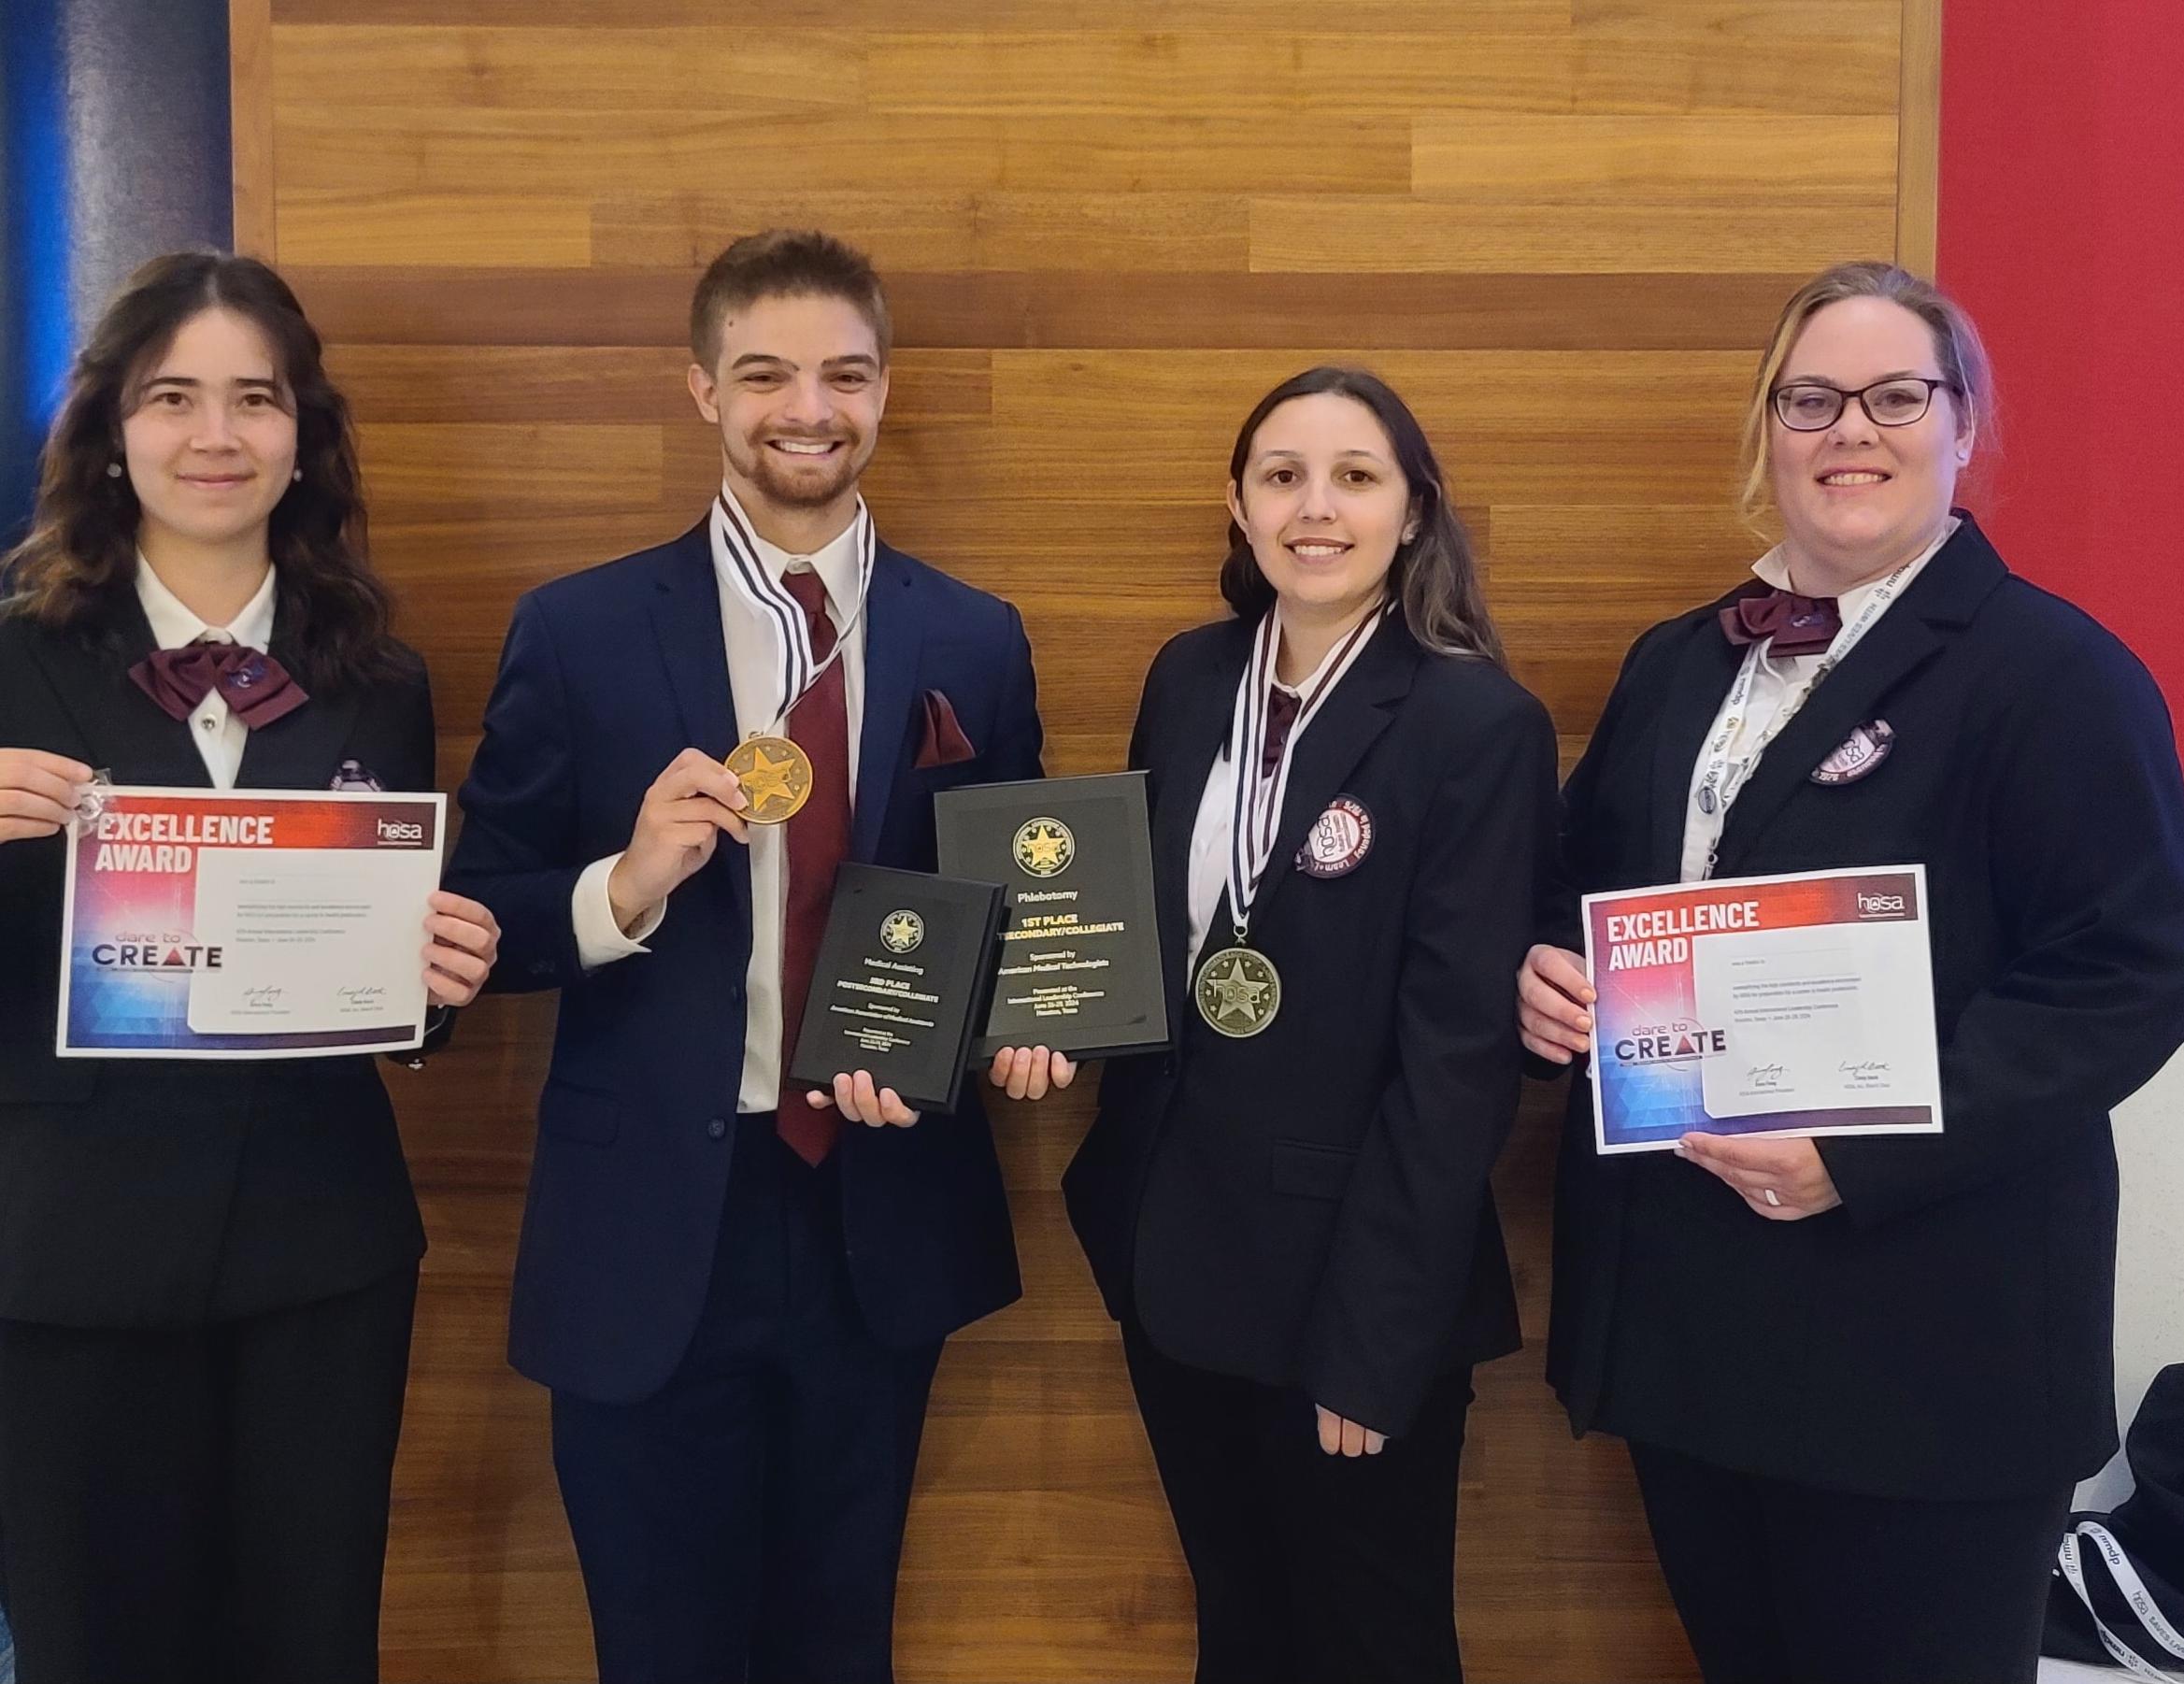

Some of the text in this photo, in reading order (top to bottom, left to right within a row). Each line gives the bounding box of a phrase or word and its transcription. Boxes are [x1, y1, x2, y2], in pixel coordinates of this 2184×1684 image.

[98, 813, 274, 845] EXCELLENCE
[378, 818, 422, 839] hosa
[1316, 815, 1335, 859] hosa
[1353, 822, 1372, 860] Founded
[95, 844, 192, 873] AWARD
[1017, 891, 1078, 904] Phlebotomy
[1857, 892, 1906, 911] hosa
[1021, 914, 1078, 928] 1ST PLACE
[1607, 901, 1760, 943] EXCELLENCE
[115, 931, 181, 944] dare to
[92, 943, 222, 968] CREATE
[1608, 936, 1689, 972] AWARD
[997, 965, 1033, 976] American
[1033, 962, 1061, 972] Medical
[885, 978, 911, 991] PLACE
[1213, 978, 1262, 1005] hosa
[1632, 1022, 1688, 1036] dare to
[1615, 1029, 1726, 1061] CREATE
[2098, 1534, 2120, 1565] nmdp
